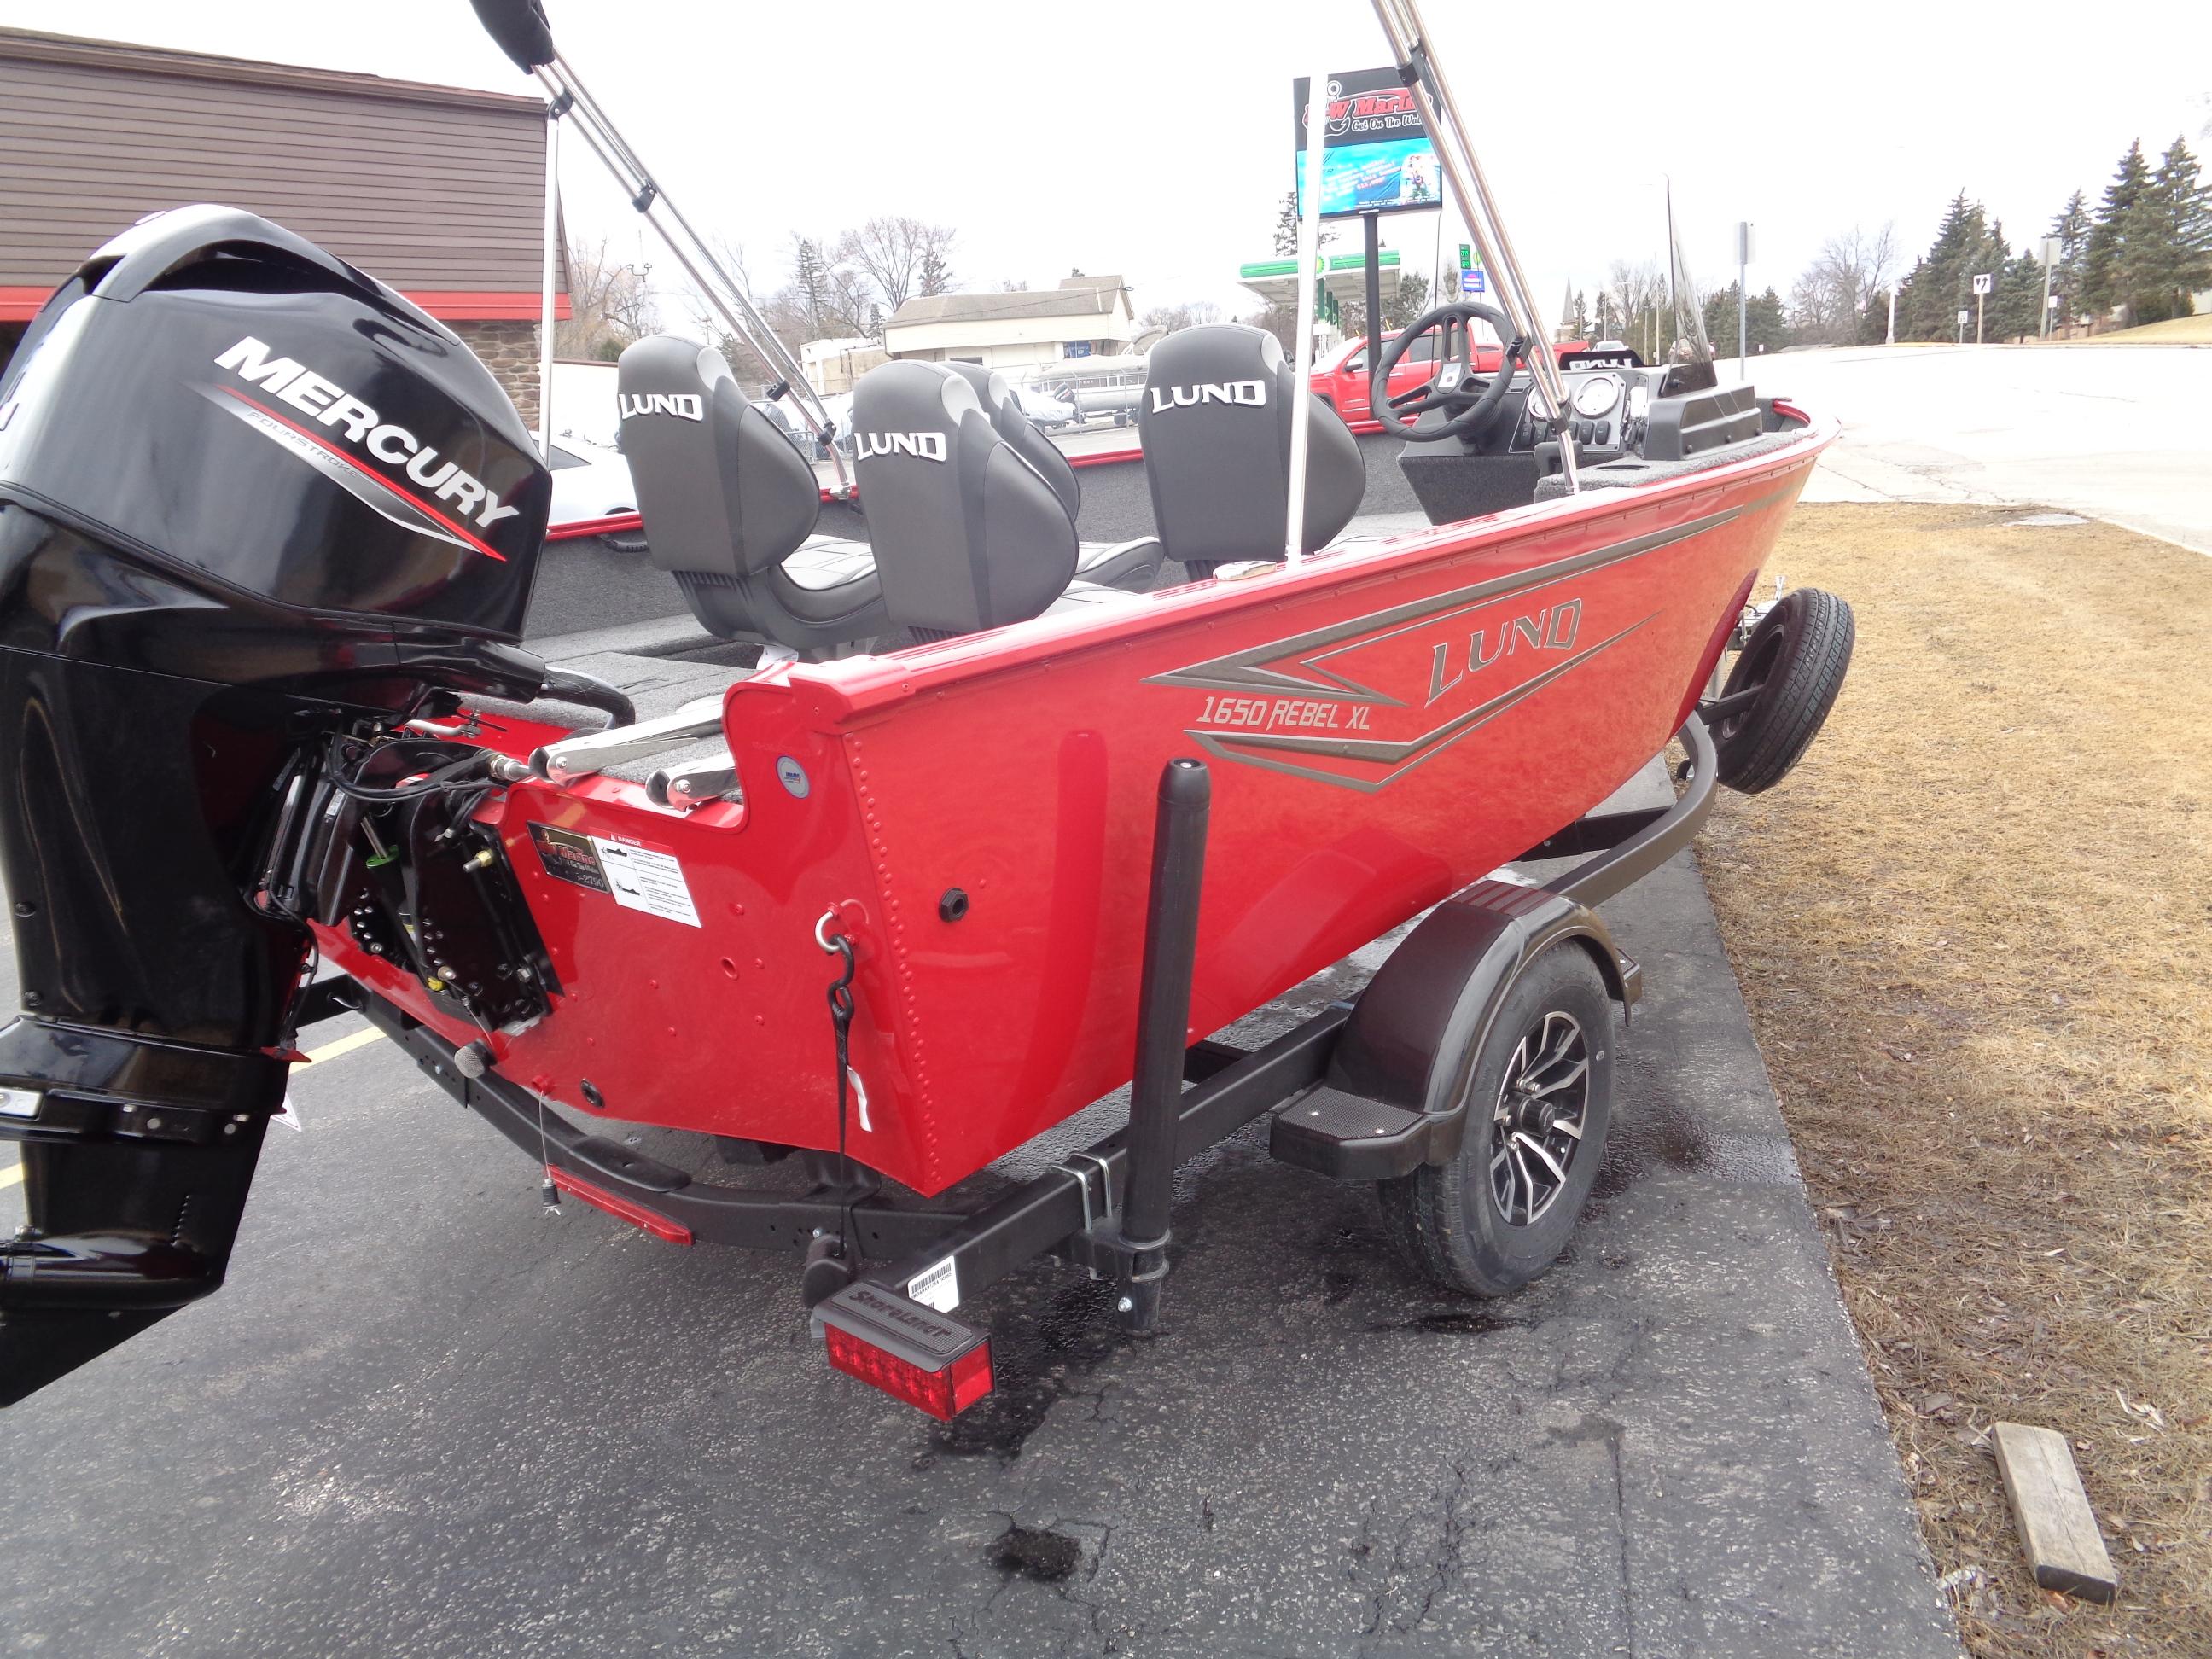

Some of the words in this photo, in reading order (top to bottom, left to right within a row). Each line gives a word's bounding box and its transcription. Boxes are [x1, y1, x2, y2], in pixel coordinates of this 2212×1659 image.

[1370, 118, 1383, 130] On
[1385, 116, 1400, 129] The
[618, 393, 703, 422] LUND
[1150, 380, 1266, 413] LUND
[213, 335, 520, 528] MERCURY
[247, 410, 358, 477] FOURSTROKE
[854, 432, 946, 463] LUND
[1424, 598, 1583, 709] LUND
[1196, 696, 1268, 726] 1650
[1266, 700, 1339, 731] REBEL
[1345, 706, 1370, 730] XL
[617, 835, 641, 847] DANGER
